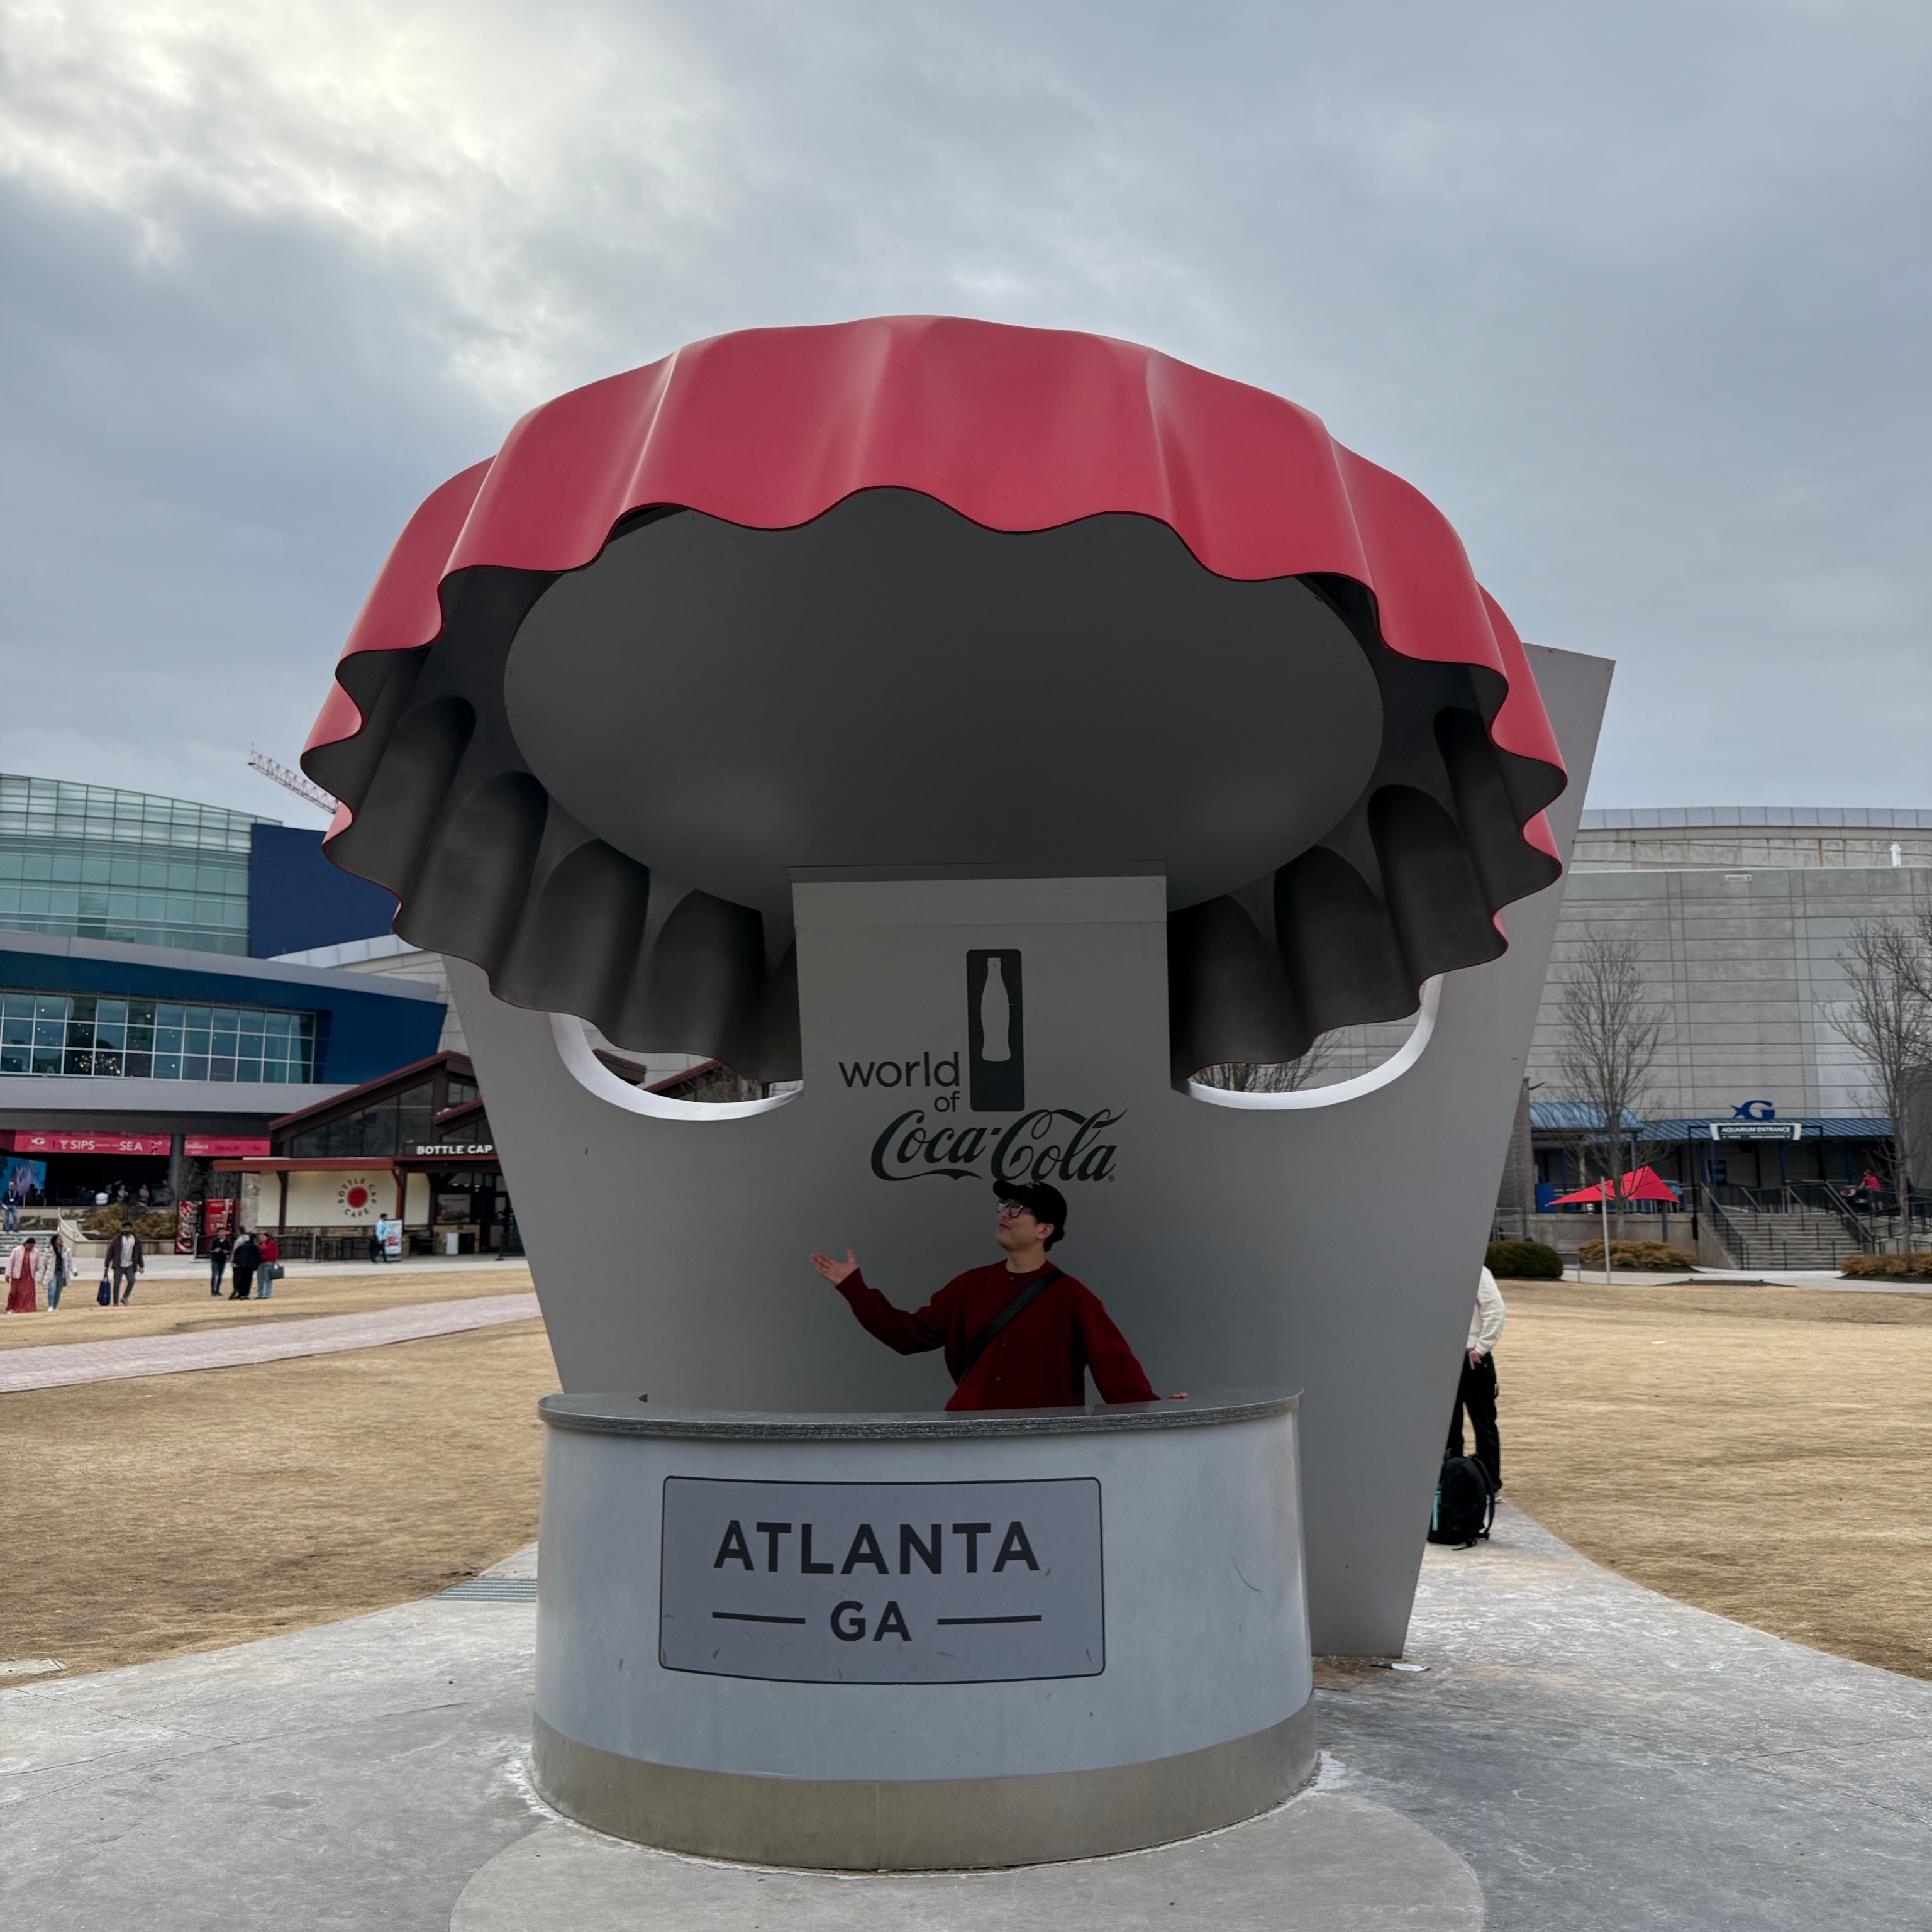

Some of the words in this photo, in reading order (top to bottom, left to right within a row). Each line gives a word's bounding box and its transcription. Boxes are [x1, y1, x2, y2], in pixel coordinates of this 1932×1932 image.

[838, 1052, 960, 1088] world
[934, 1091, 960, 1113] of
[70, 1140, 95, 1150] SIPS
[119, 1141, 143, 1151] SEA
[416, 1145, 465, 1155] BOTTLE
[467, 1145, 493, 1154] CAP
[871, 1108, 1128, 1182] Coca-Cola
[338, 1177, 365, 1204] BOTTLE
[369, 1184, 377, 1204] CAP
[344, 1207, 370, 1218] CAFE
[713, 1519, 1040, 1574] ATLANTA
[830, 1600, 912, 1642] GA
